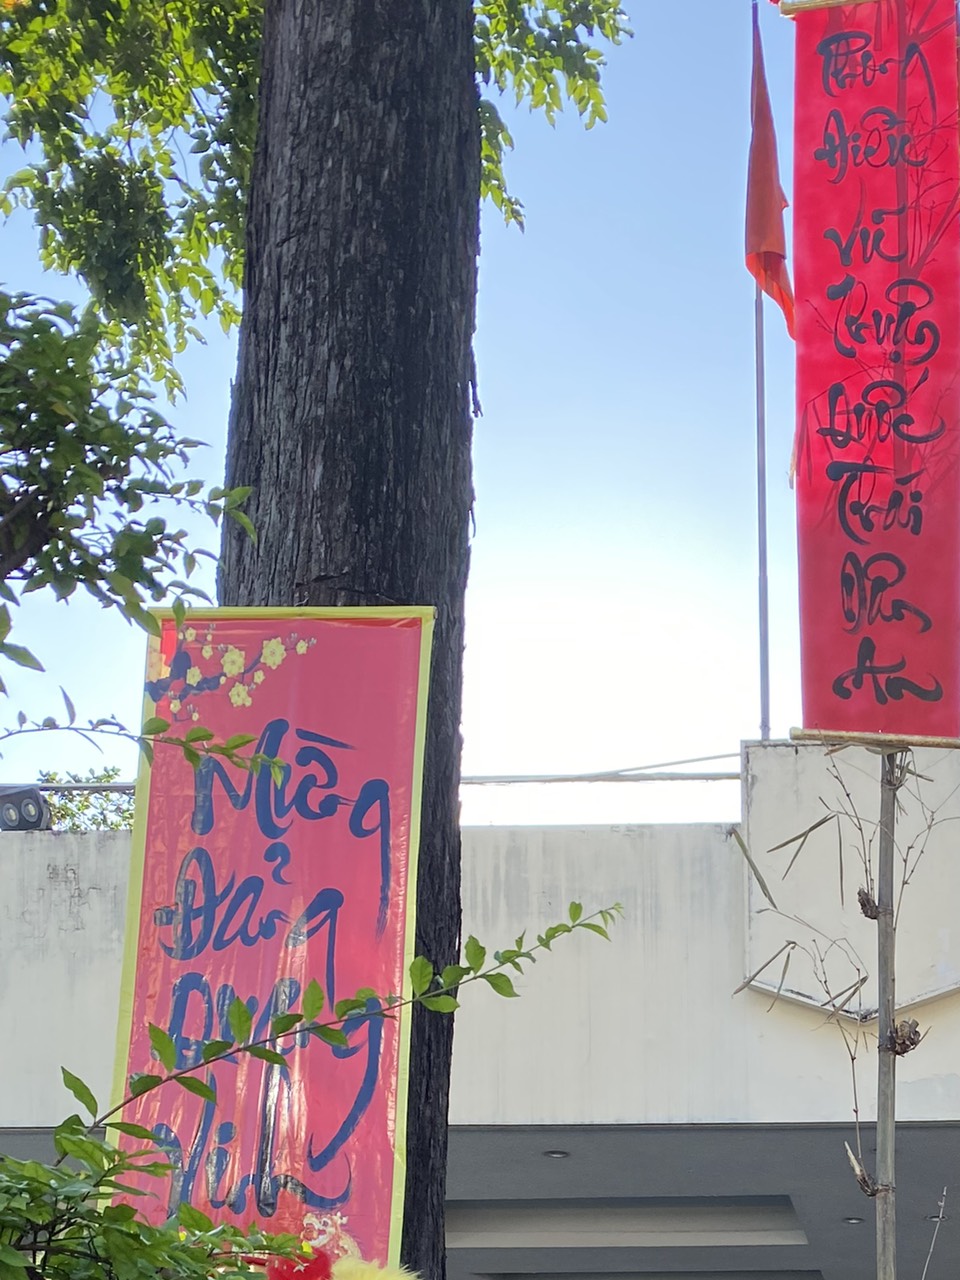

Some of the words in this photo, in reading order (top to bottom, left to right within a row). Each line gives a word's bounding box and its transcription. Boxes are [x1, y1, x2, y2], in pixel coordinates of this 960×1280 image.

[831, 636, 943, 705] An
[191, 718, 391, 944] Mừng
[154, 841, 344, 1013] Đảng
